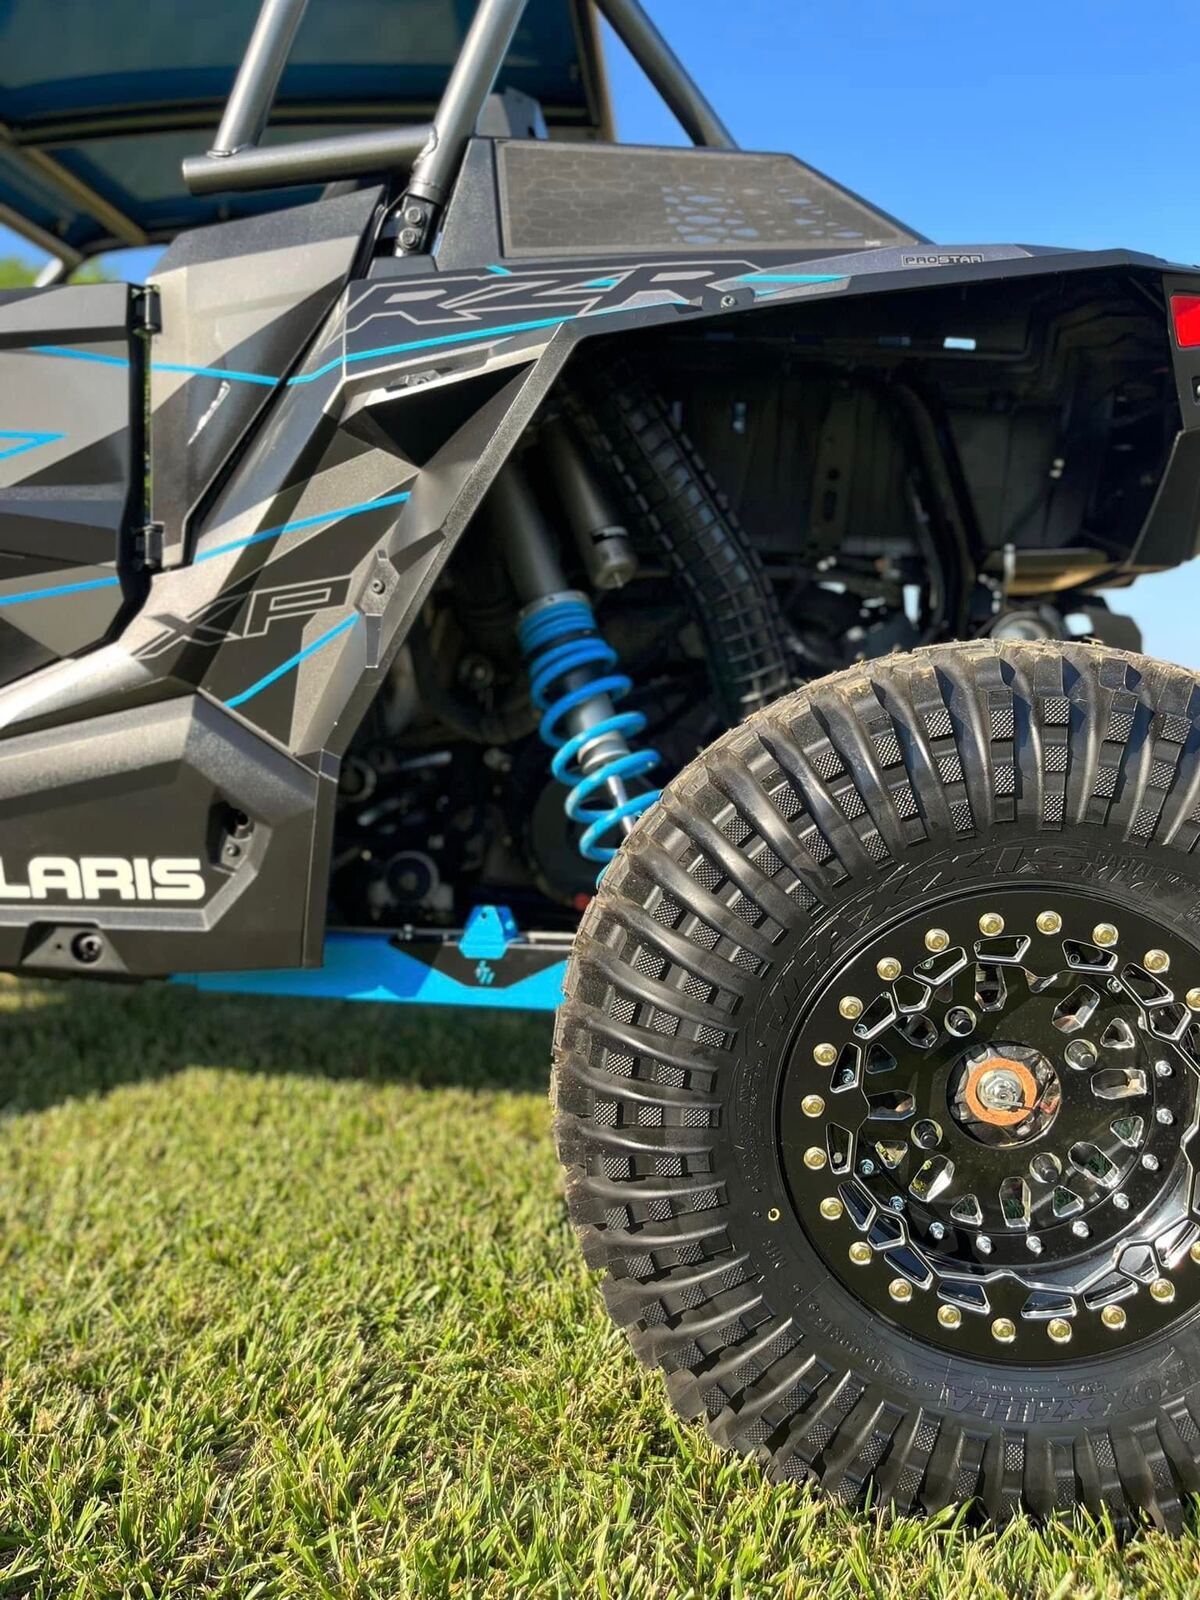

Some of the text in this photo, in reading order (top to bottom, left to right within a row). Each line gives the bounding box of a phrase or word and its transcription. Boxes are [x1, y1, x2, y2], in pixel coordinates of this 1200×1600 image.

[345, 260, 764, 324] RZR
[904, 254, 982, 266] PROSTAR
[130, 575, 352, 661] XP
